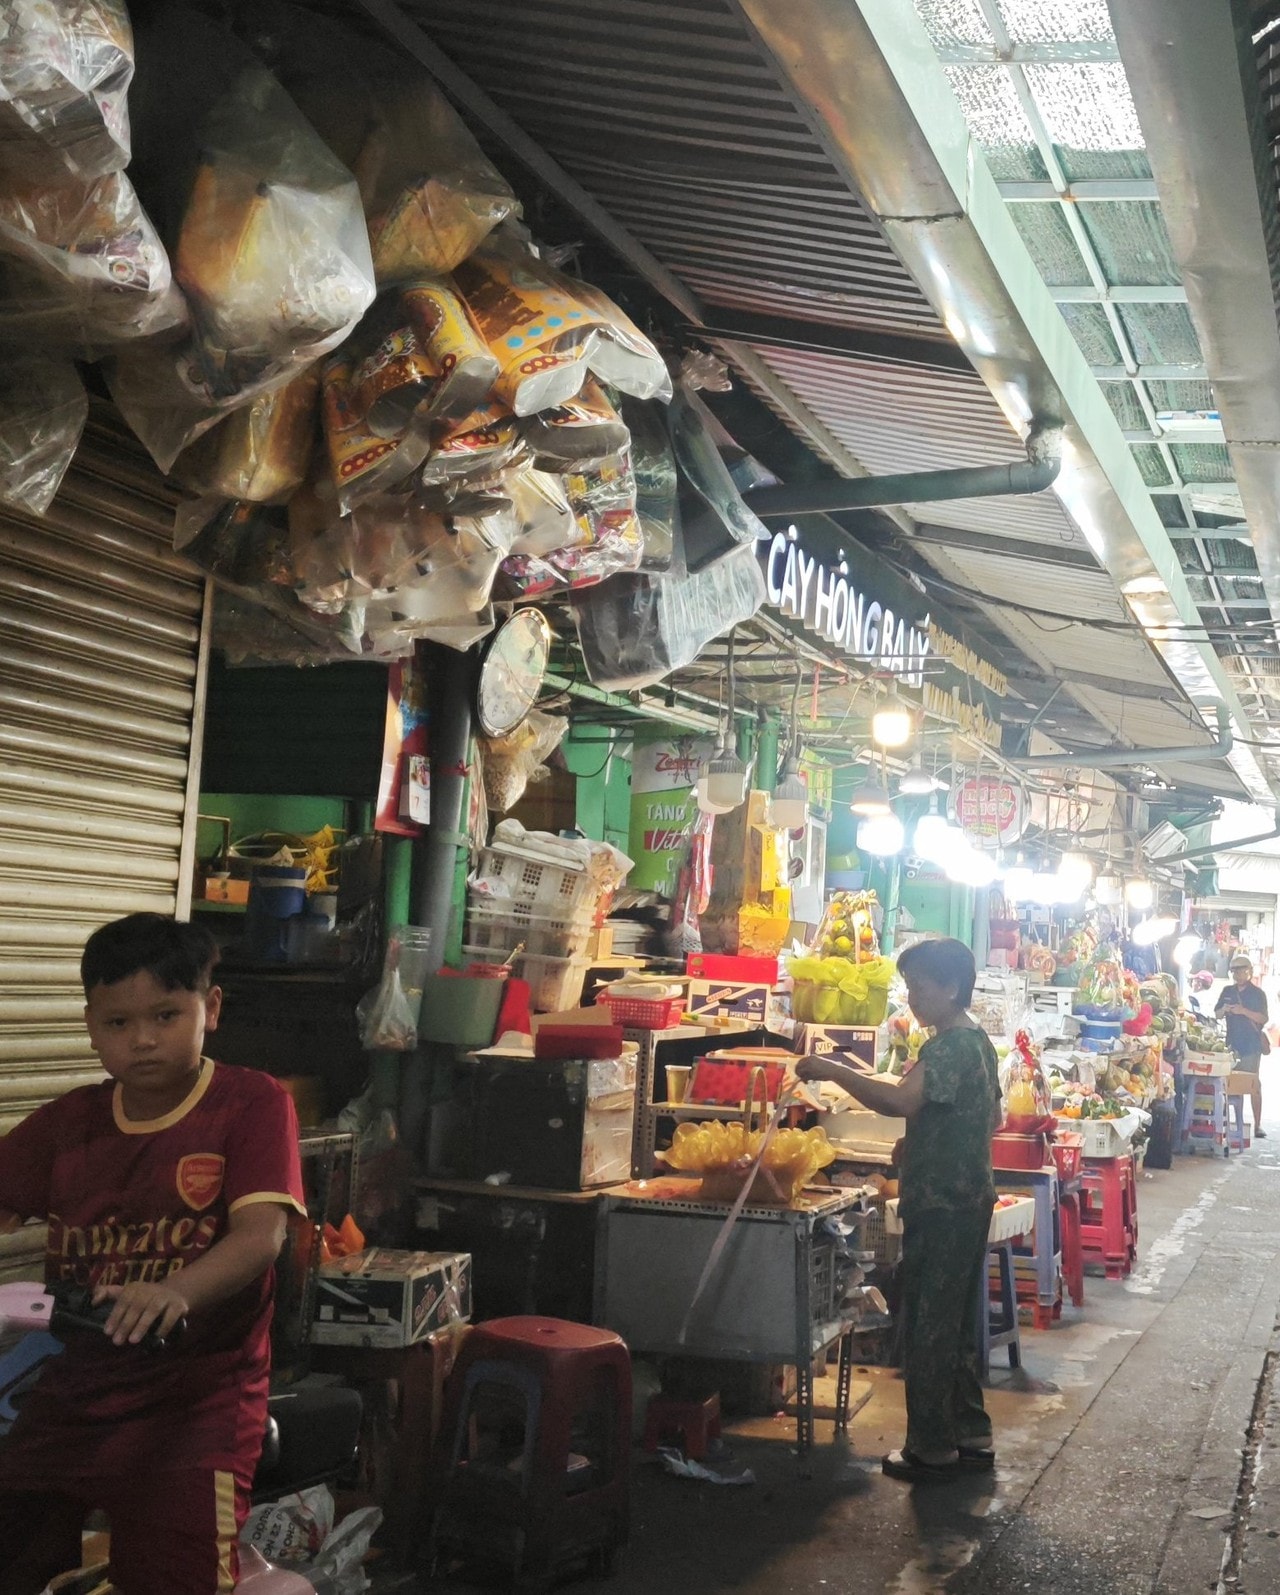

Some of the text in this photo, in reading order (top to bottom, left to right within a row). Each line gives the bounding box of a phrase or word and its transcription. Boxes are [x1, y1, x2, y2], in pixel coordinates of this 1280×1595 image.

[767, 524, 815, 620] CÂY
[815, 548, 882, 663] HỒNG
[816, 1041, 833, 1053] VIP
